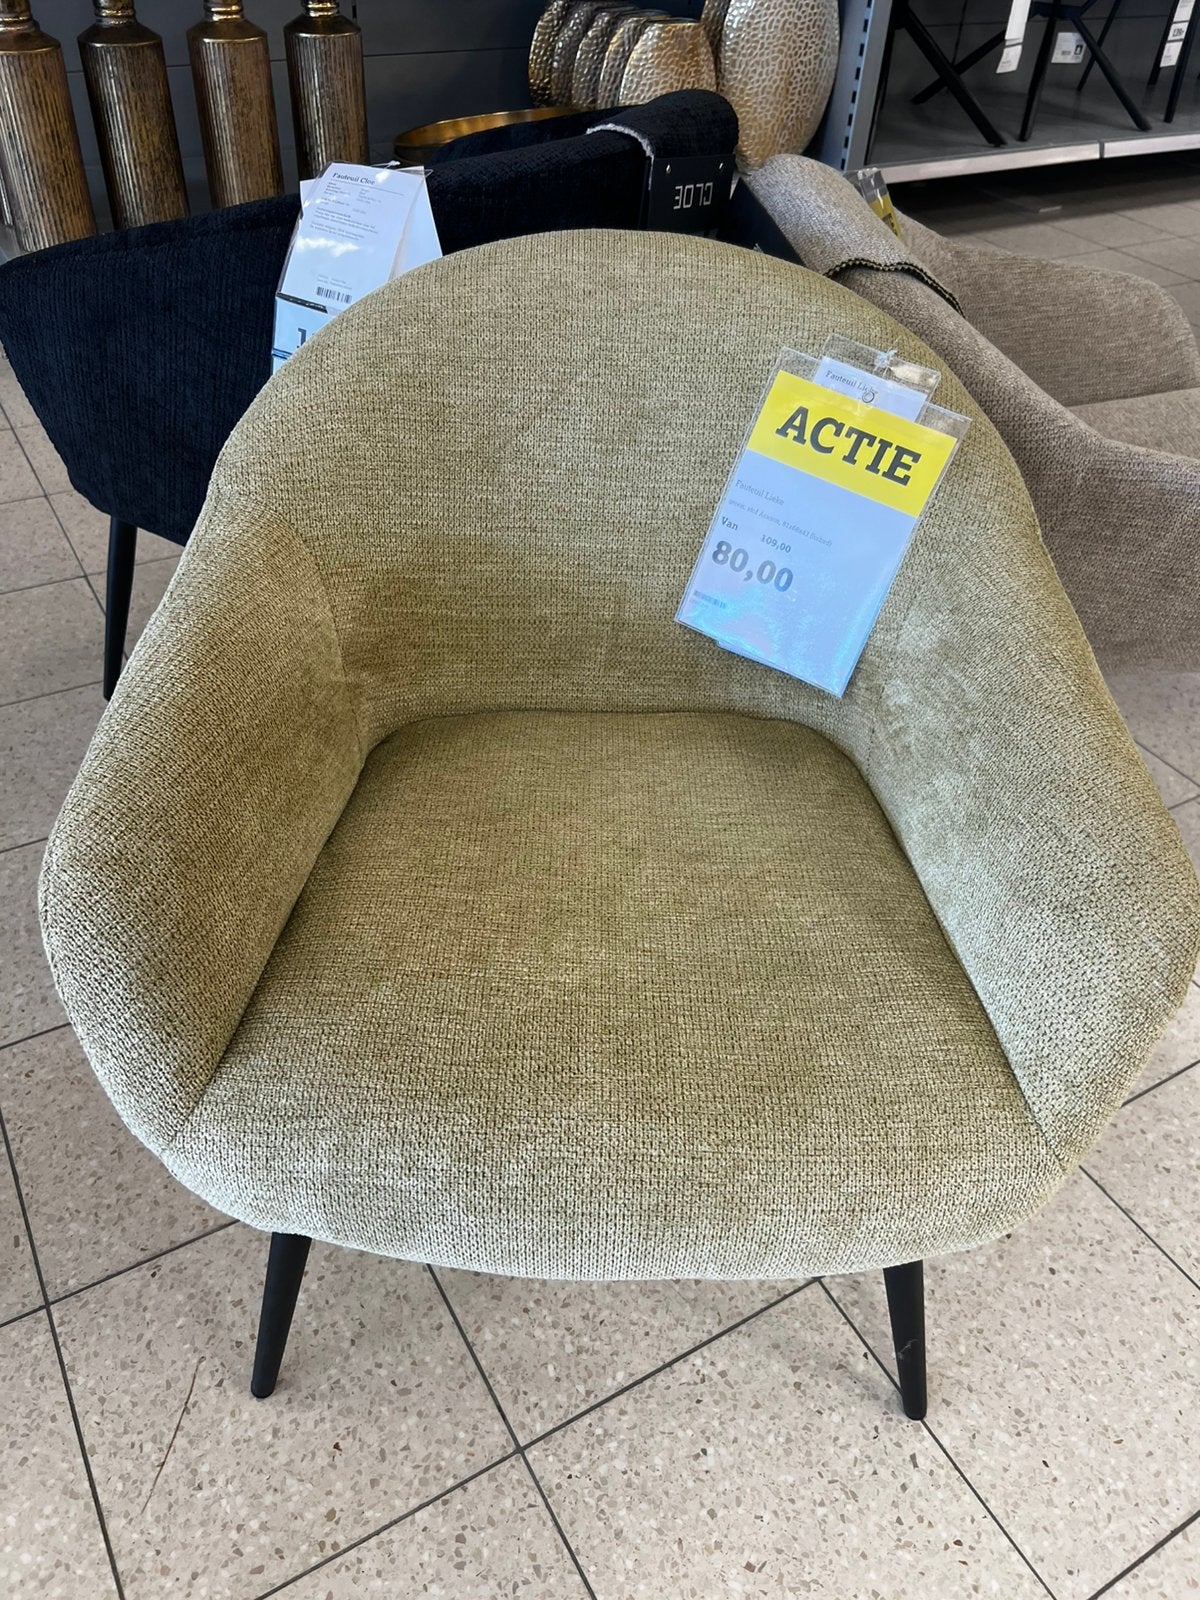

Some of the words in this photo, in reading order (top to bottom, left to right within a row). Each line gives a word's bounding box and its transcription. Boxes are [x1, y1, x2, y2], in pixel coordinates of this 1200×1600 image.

[825, 369, 857, 388] Fauteuil
[775, 405, 922, 487] ACTIE
[721, 516, 739, 531] Van
[761, 533, 793, 554] 109,00
[711, 540, 794, 593] 80,00
